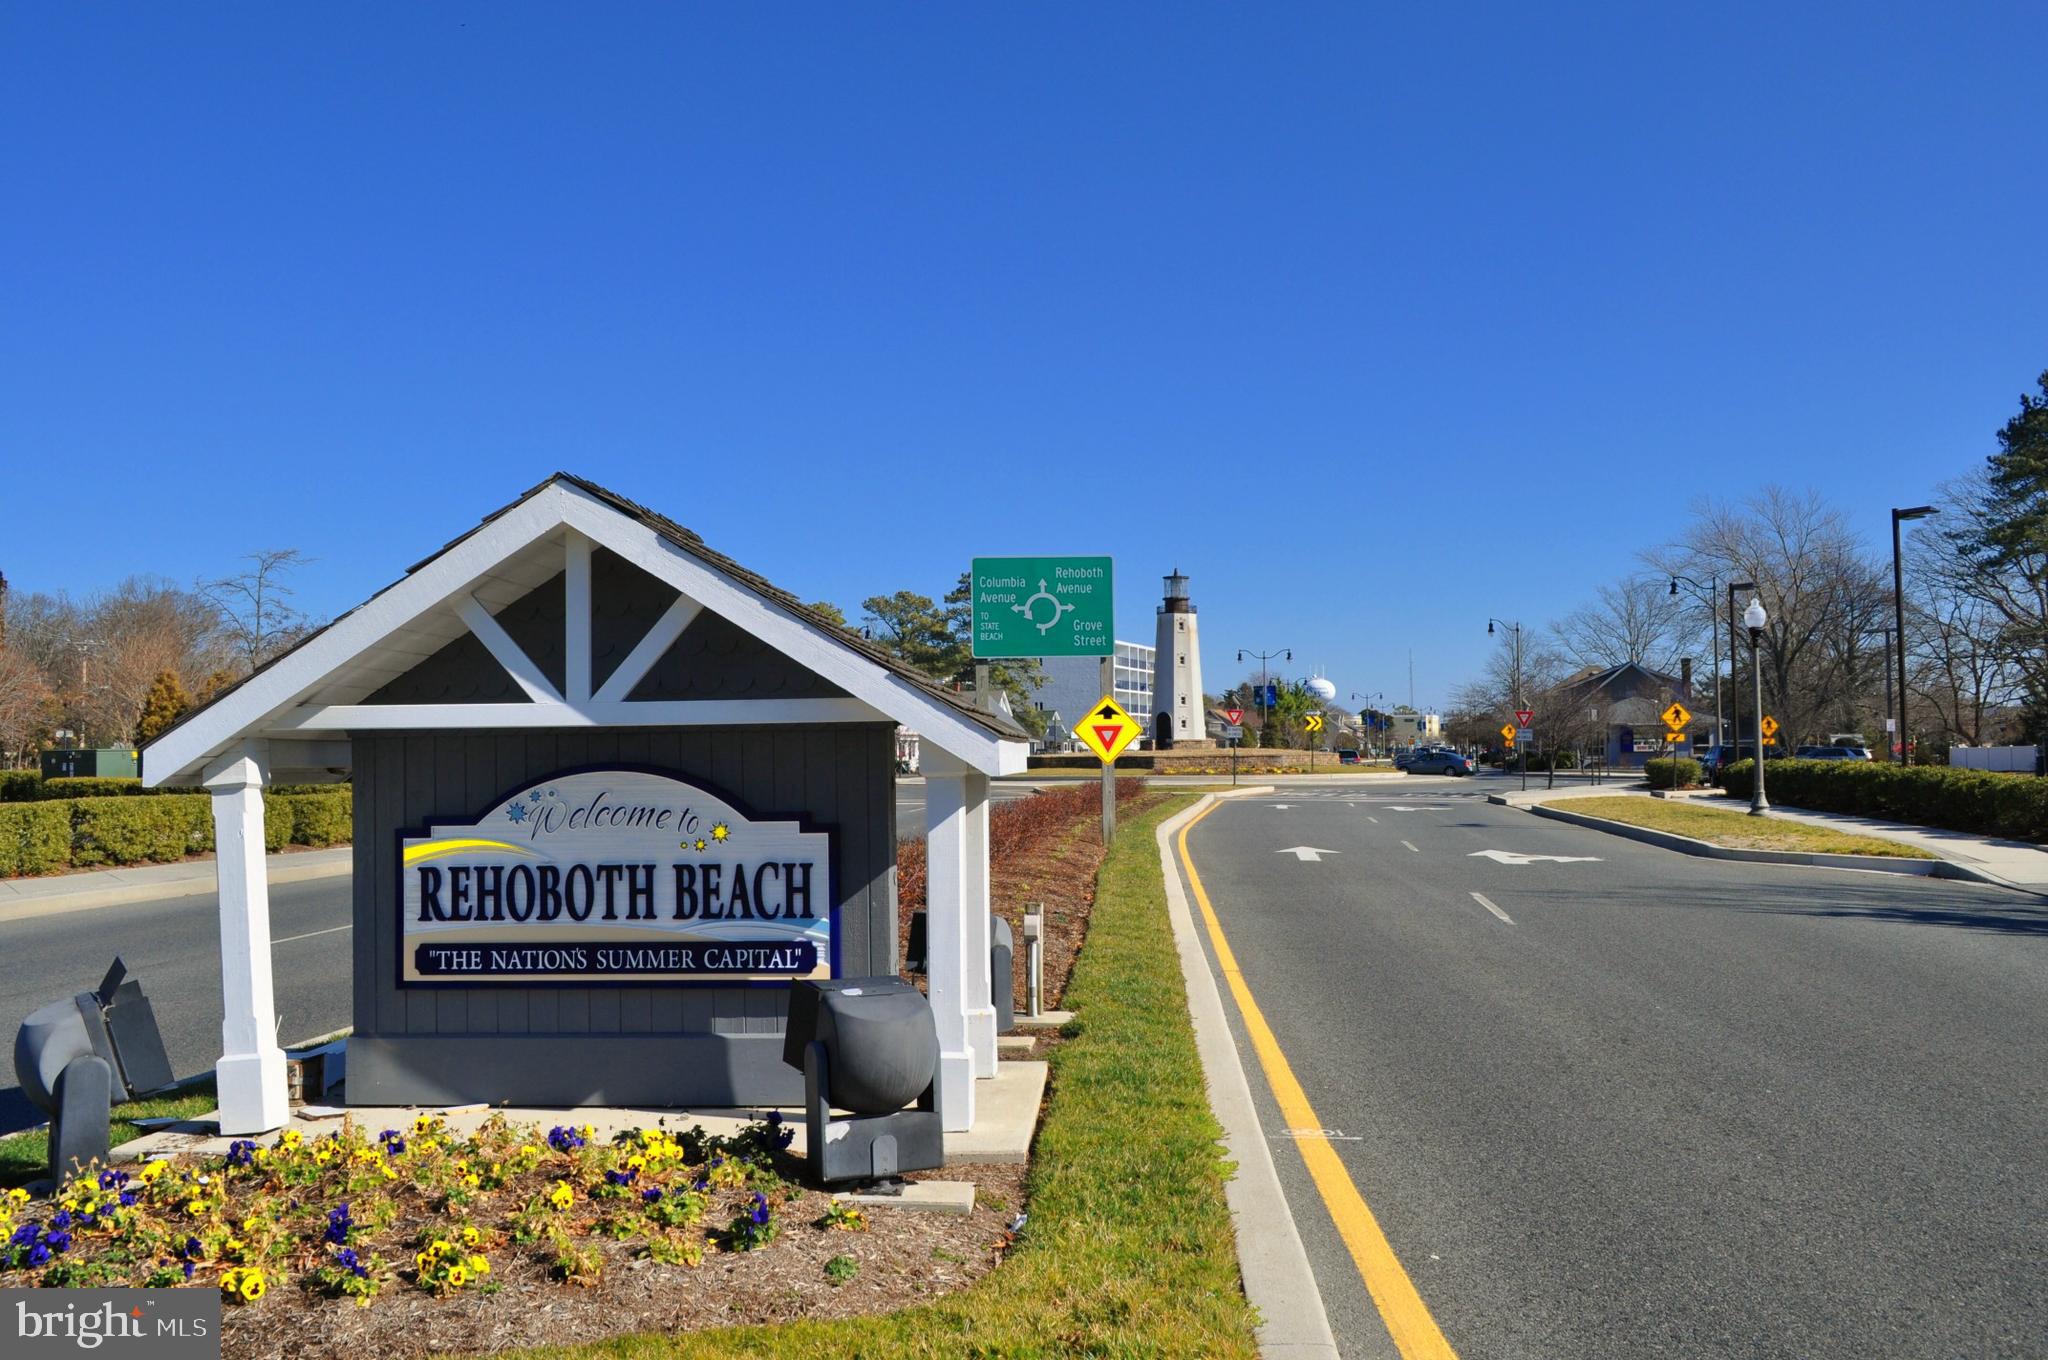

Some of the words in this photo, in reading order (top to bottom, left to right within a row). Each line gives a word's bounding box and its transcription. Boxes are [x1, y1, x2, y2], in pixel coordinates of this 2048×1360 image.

[1055, 567, 1103, 578] Rehoboth
[980, 576, 1026, 588] Columbia
[1056, 583, 1092, 594] Avenue
[980, 592, 1016, 603] Avenue
[980, 612, 989, 620] TO
[980, 622, 1000, 631] STATE
[1073, 620, 1102, 631] Grove
[980, 632, 1003, 640] BEACH
[1074, 635, 1106, 647] Street
[528, 791, 672, 841] Welcome
[677, 808, 699, 834] to
[417, 863, 657, 922] REHOBOTH
[672, 861, 815, 921] BEACH
[429, 950, 482, 970] "THE
[491, 947, 587, 970] NATION'S
[596, 949, 696, 969] SUMMER
[704, 948, 802, 969] CAPITAL"
